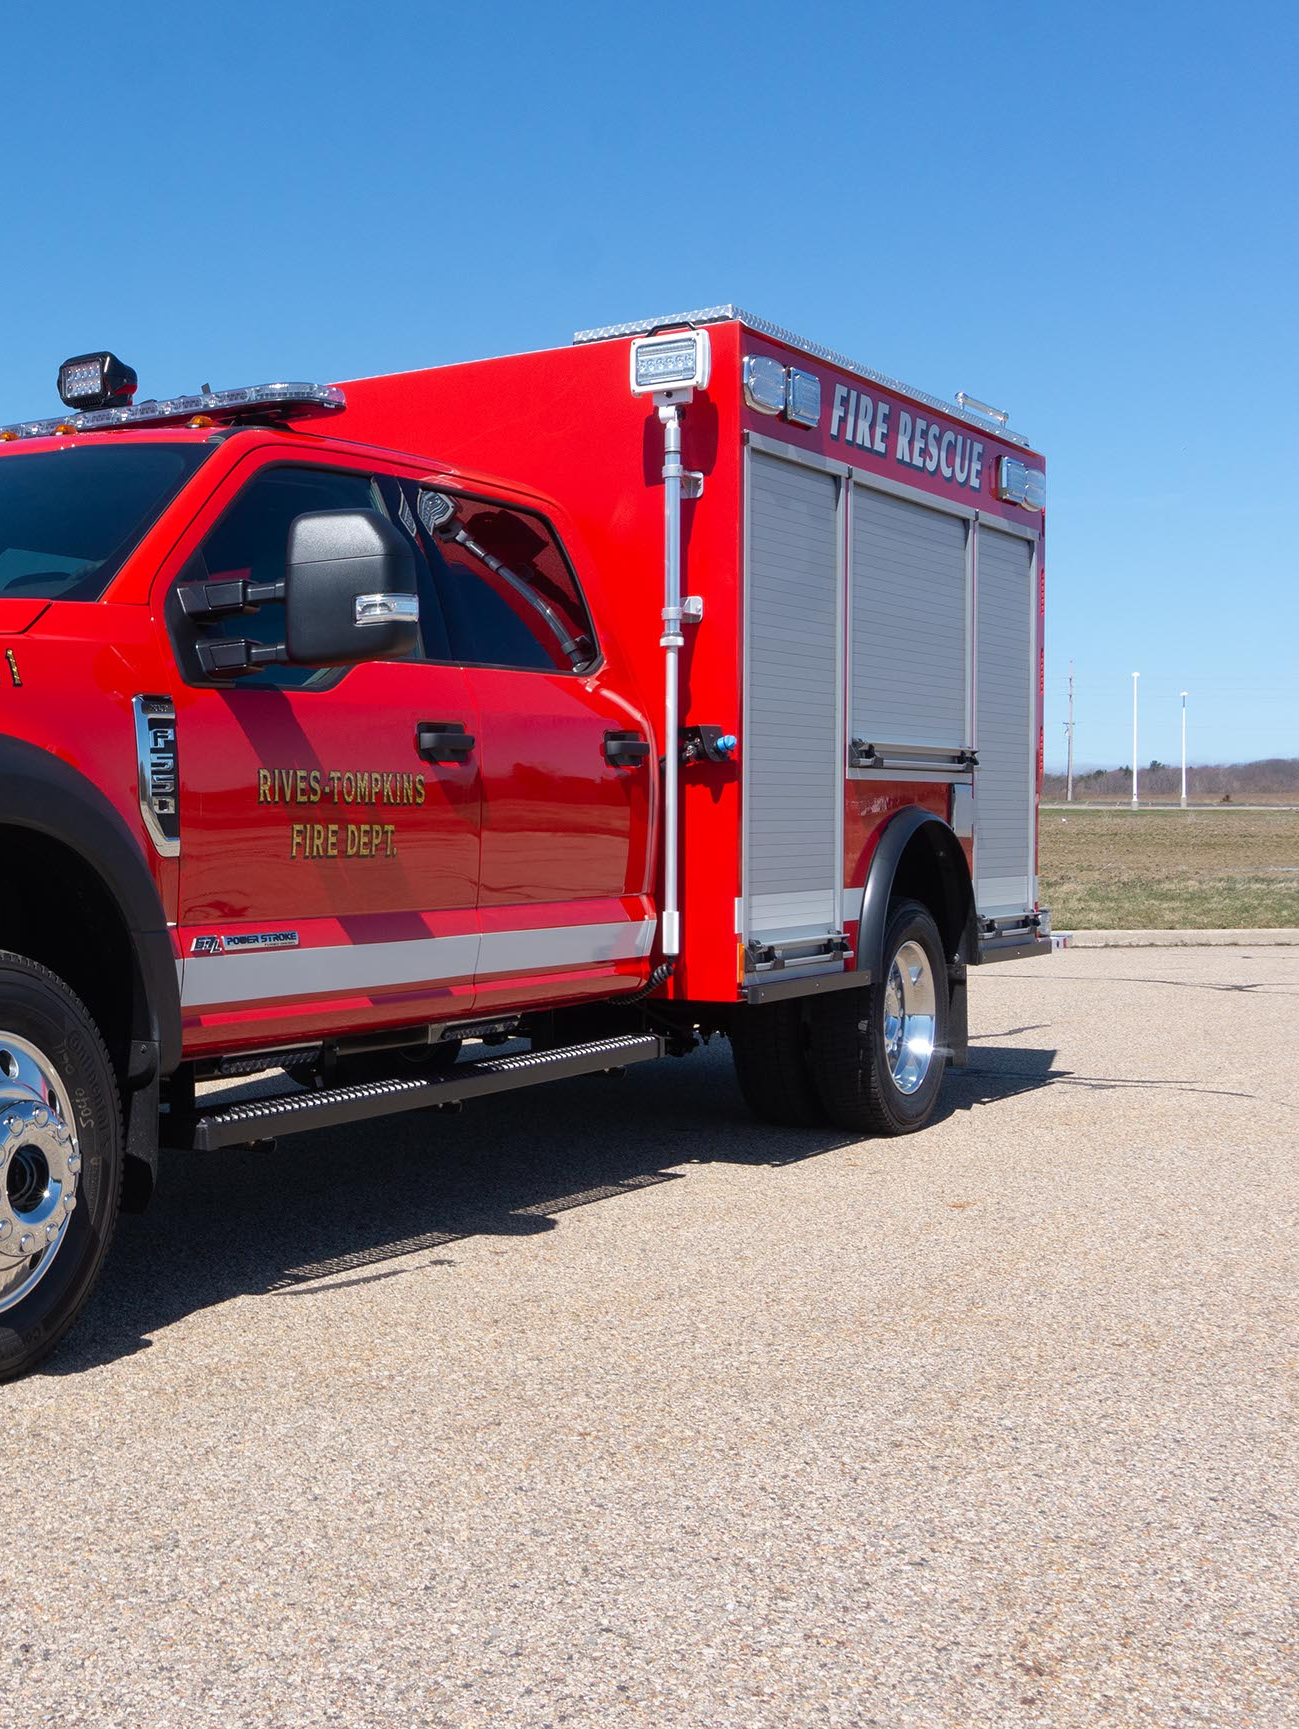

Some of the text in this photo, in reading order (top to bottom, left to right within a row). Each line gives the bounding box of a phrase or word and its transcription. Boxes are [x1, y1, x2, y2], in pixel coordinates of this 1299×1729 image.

[830, 383, 984, 492] FIRE RESCUE
[5, 648, 22, 687] 1
[258, 768, 426, 806] RIVES-TOMPKINS
[290, 823, 397, 859] FIRE DEPT.
[227, 932, 297, 946] POWER STROKE
